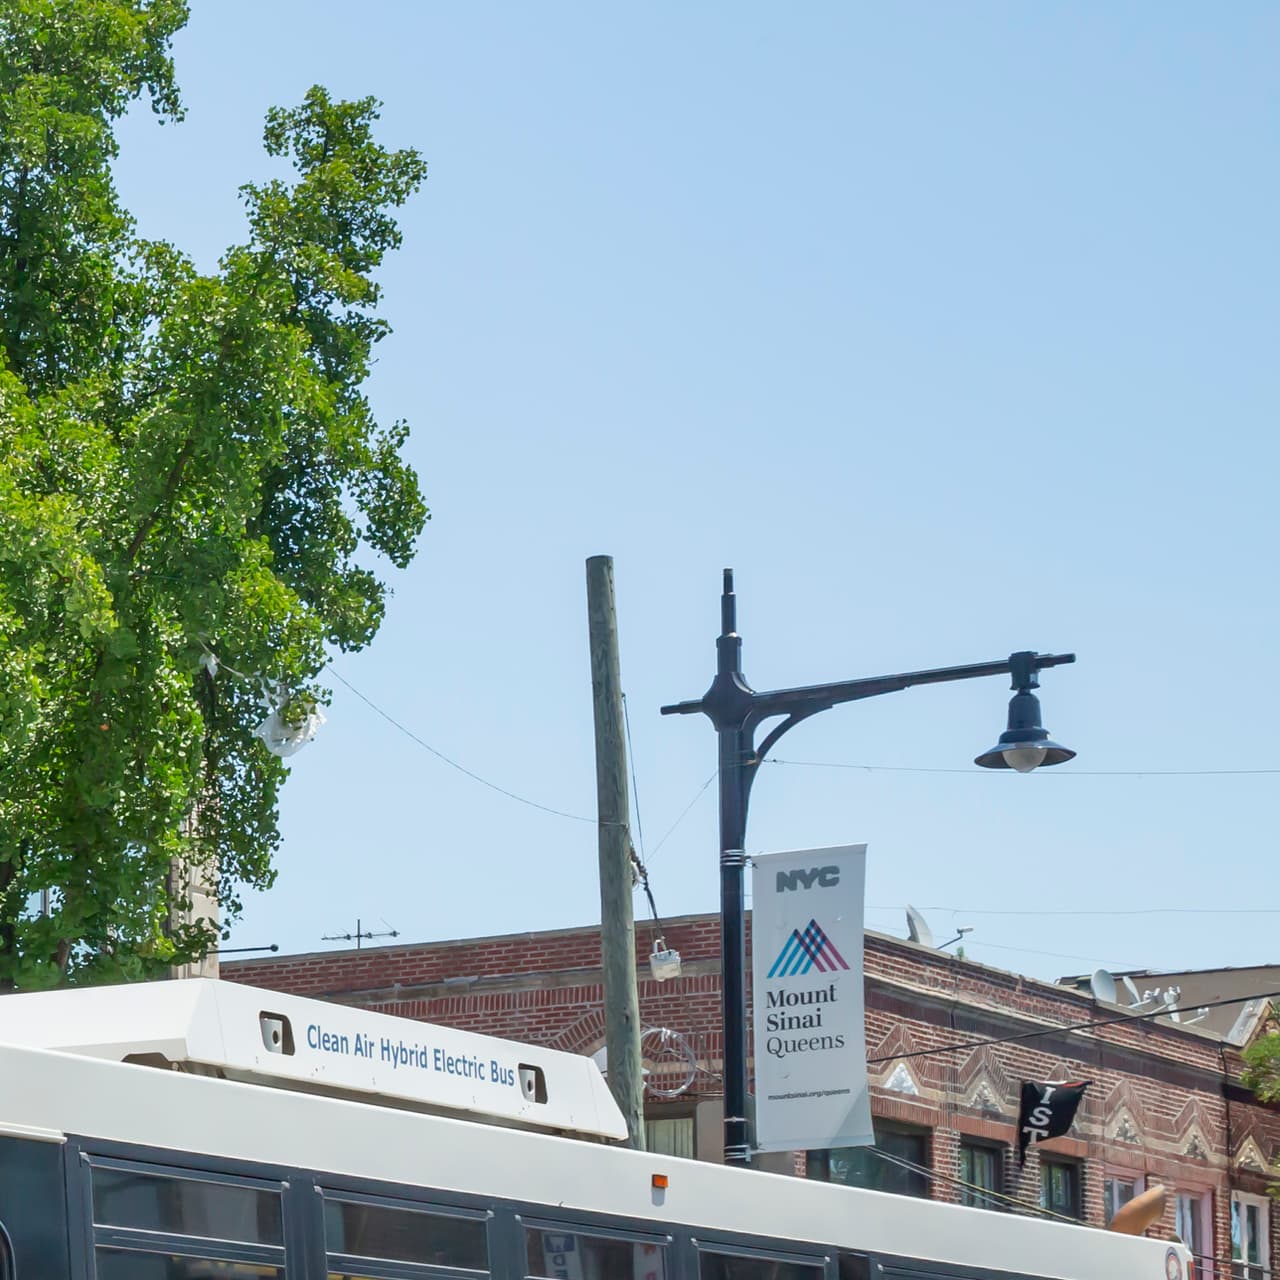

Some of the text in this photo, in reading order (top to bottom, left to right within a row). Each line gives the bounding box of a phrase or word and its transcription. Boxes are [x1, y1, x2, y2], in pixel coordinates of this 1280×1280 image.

[776, 865, 840, 893] NYC
[766, 984, 838, 1009] Mount
[766, 1008, 822, 1032] Sinai
[307, 1024, 515, 1086] Clean Air Hybrid Electric Bus
[766, 1033, 845, 1059] Queens
